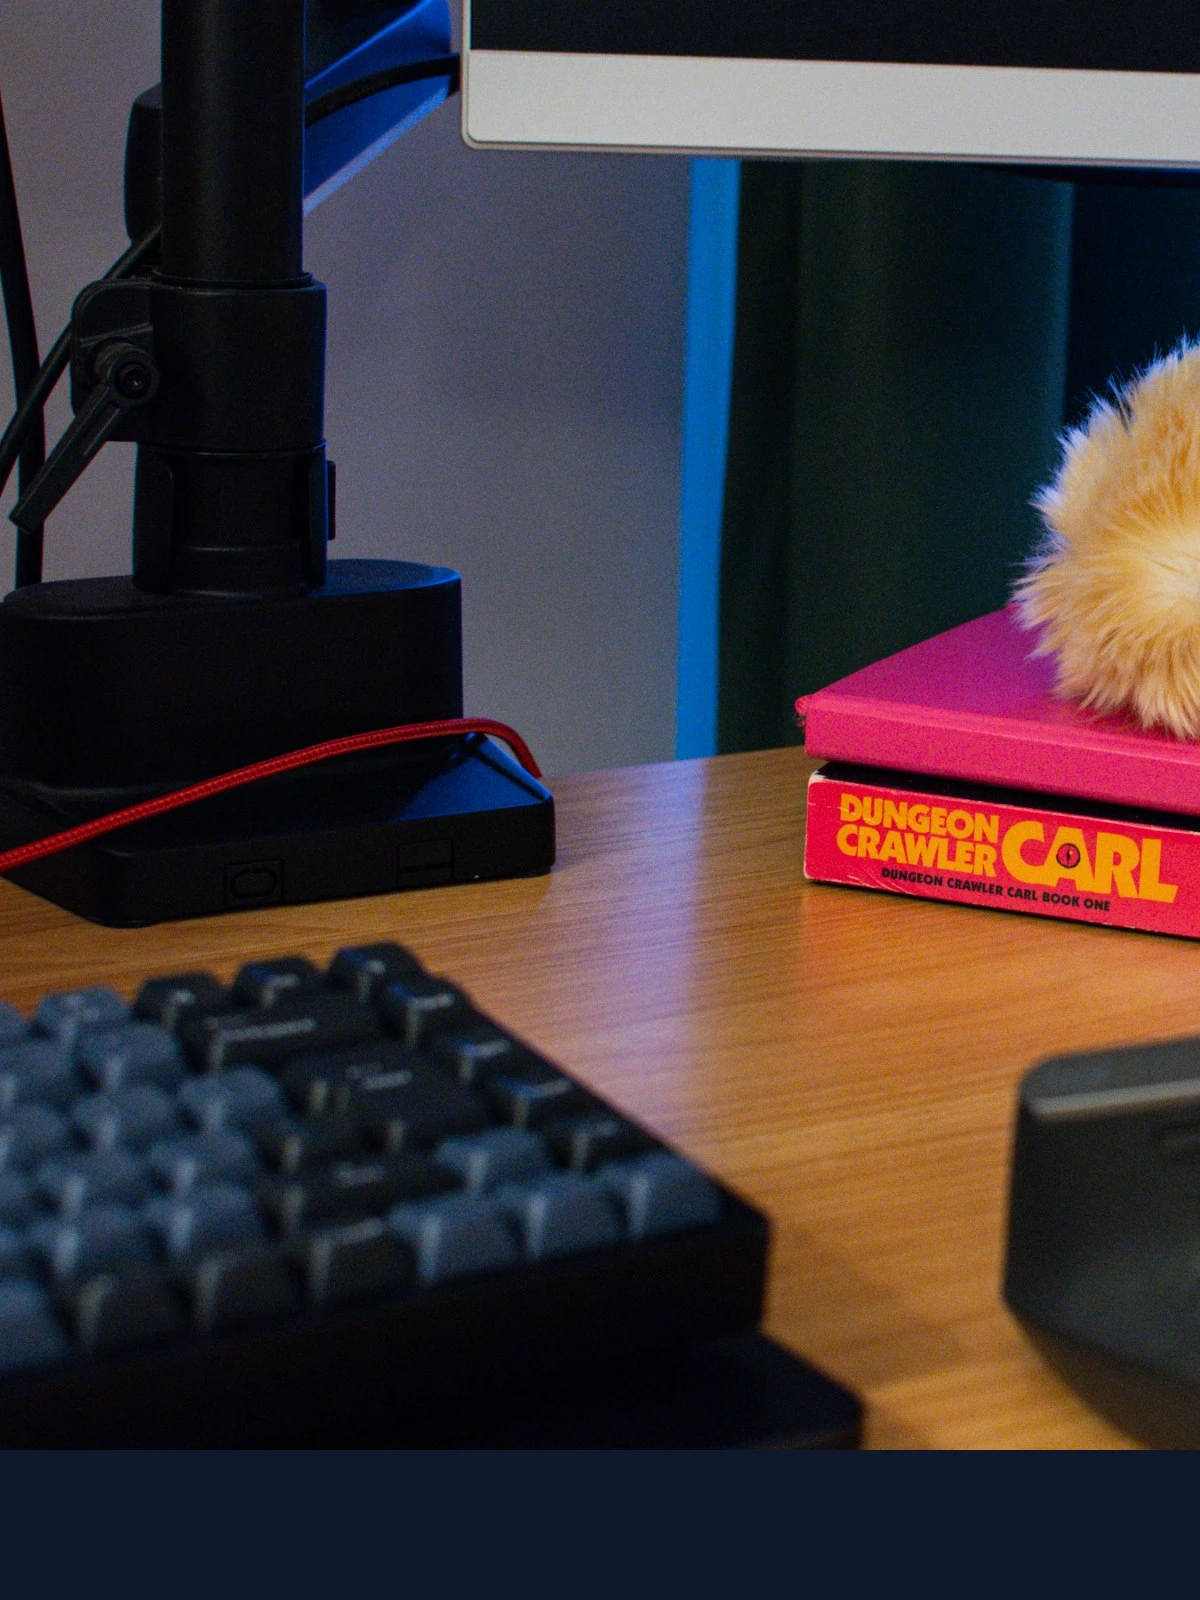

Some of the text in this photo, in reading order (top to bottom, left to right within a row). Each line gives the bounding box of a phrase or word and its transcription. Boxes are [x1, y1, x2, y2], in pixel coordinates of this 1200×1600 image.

[840, 793, 1000, 844] DUNGEON
[836, 824, 998, 878] CRAWLER
[1001, 820, 1179, 904] CARL
[881, 867, 1112, 912] DUNGEON CRAWLER CARL BOOK ONE
